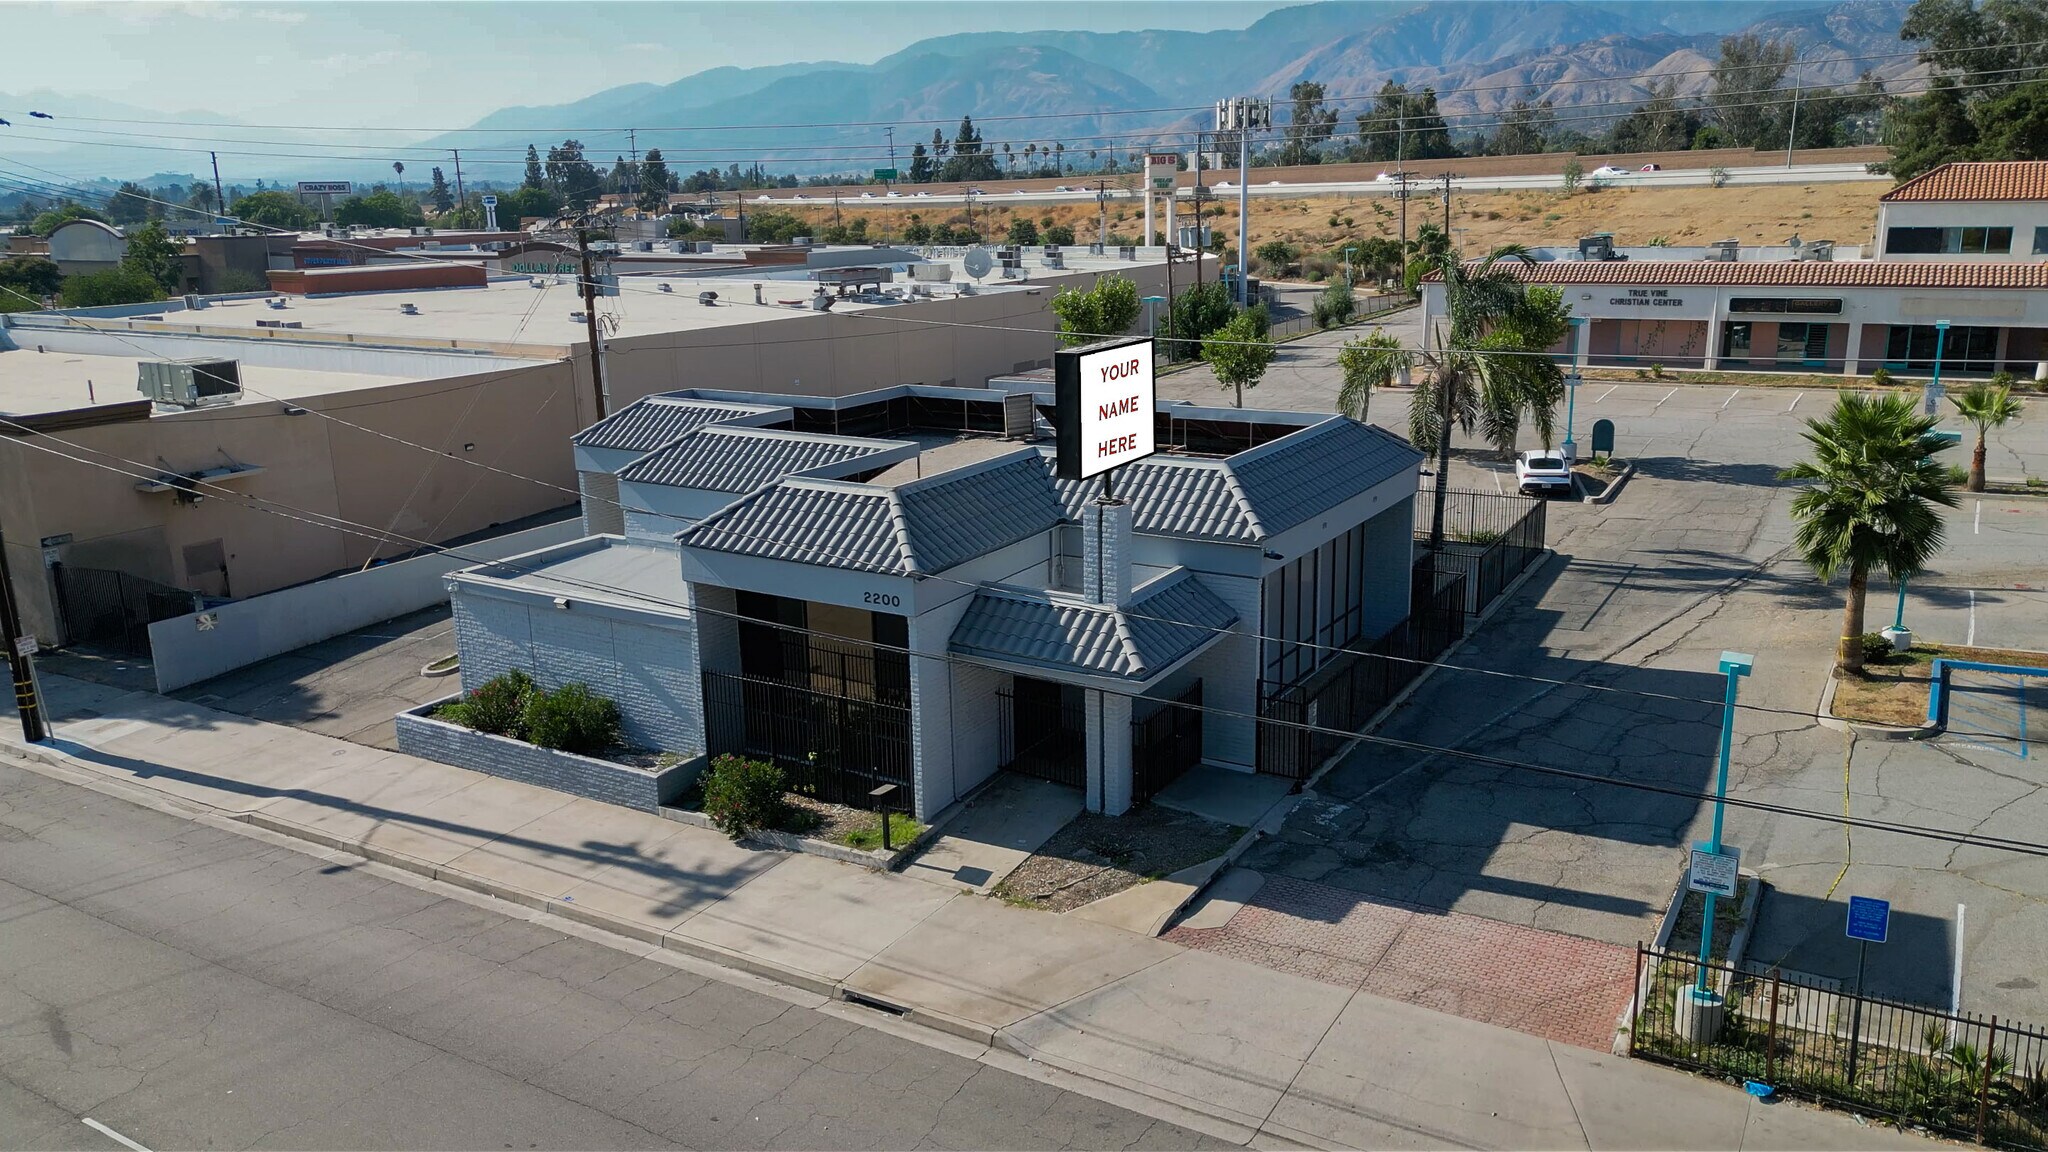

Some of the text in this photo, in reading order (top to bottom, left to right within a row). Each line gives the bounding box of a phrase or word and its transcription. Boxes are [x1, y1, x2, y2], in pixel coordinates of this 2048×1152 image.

[1151, 156, 1166, 165] BIG
[304, 184, 327, 192] CRAZY
[512, 263, 549, 273] DOLLAR
[1628, 289, 1669, 297] TRUE VINE
[1609, 298, 1683, 307] CHRISTIAN CENTER
[1100, 358, 1139, 383] YOUR
[1098, 395, 1139, 421] NAME
[1098, 433, 1137, 458] HERE
[863, 591, 901, 607] 2200
